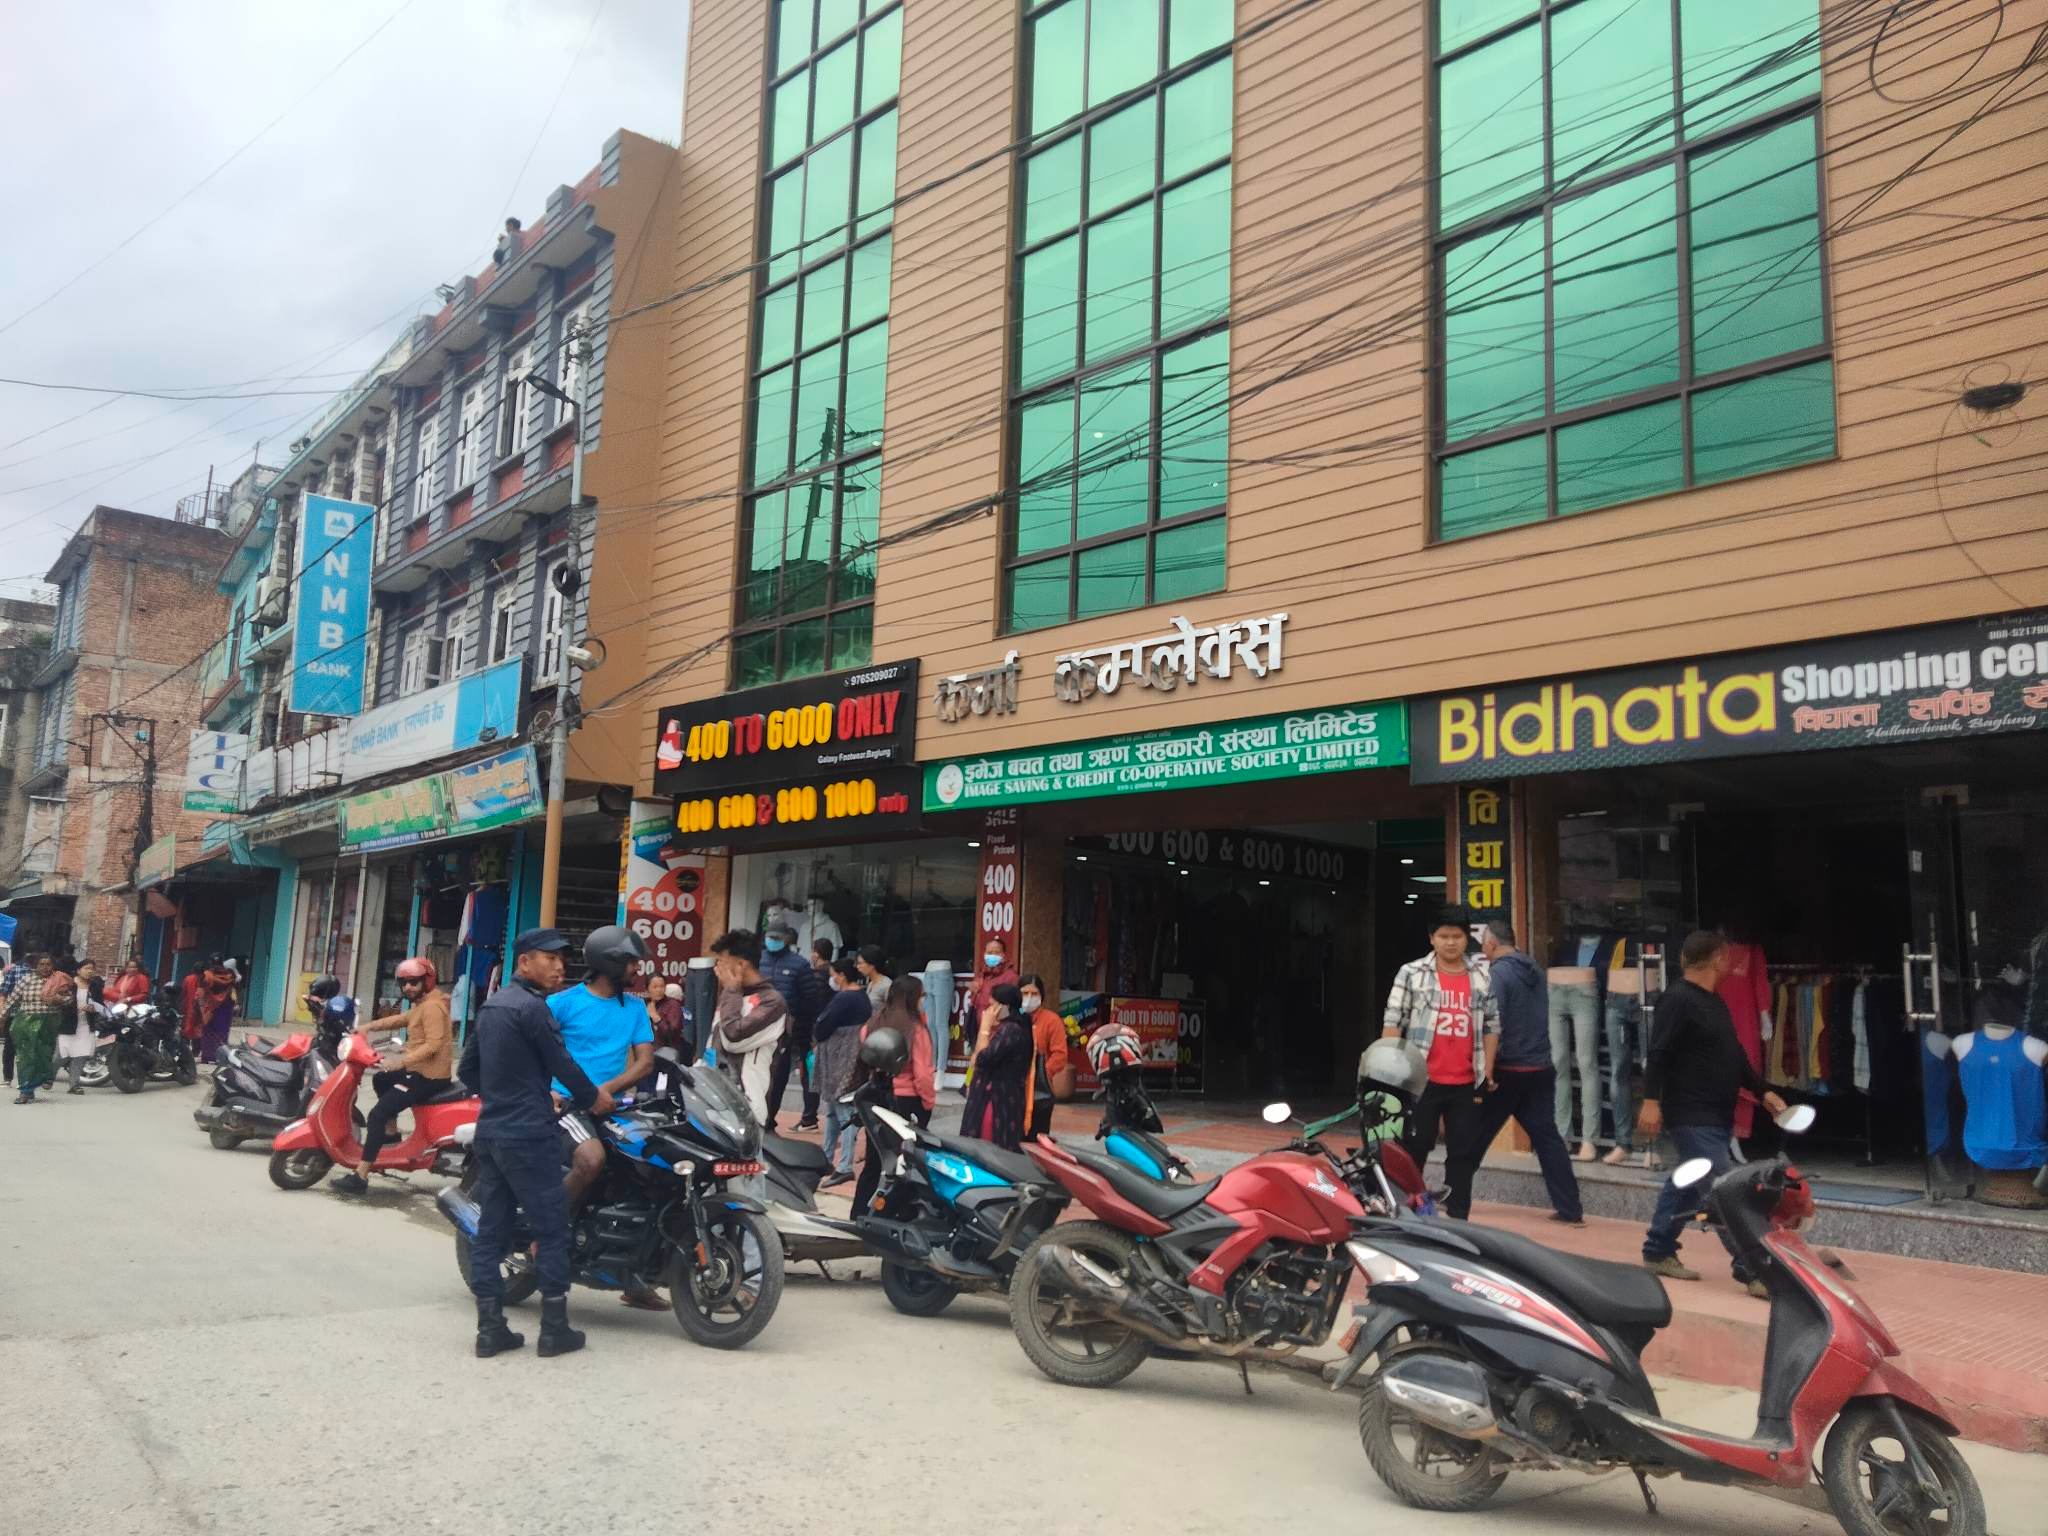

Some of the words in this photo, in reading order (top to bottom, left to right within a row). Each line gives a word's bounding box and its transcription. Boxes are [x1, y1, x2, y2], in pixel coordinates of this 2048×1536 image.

[307, 661, 351, 678] BANK
[1439, 666, 1777, 765] Bidhata
[1782, 650, 1971, 703] Shopping
[686, 719, 730, 762] 400
[735, 713, 762, 756] TO
[766, 701, 833, 751] 6000
[837, 690, 900, 741] ONLY
[965, 757, 1003, 783] इमेज
[1007, 756, 1044, 776] बचत
[1049, 751, 1084, 773] तथा
[1088, 744, 1130, 768] ऋण
[1135, 731, 1214, 762] सहकारी
[1219, 728, 1278, 754] संस्था
[1284, 710, 1379, 744] लिमिटेड
[964, 782, 1001, 799] IMAGE
[1004, 776, 1049, 796] SAVING
[1052, 776, 1063, 791] &
[1067, 768, 1115, 790] CREDIT
[1119, 757, 1227, 782] CO-OPERATIVE
[1231, 748, 1301, 772] SOCIETY
[1305, 739, 1380, 763] LIMITED
[677, 799, 714, 833] 400
[718, 793, 756, 829] 600
[776, 785, 817, 824] 800
[823, 777, 876, 819] 1000
[1161, 830, 1208, 864] 600
[1219, 836, 1234, 862] &
[1242, 837, 1284, 872] 800
[1293, 843, 1344, 882] 1000
[984, 864, 1015, 894] 400
[634, 891, 696, 912] 400
[982, 901, 1014, 933] 600
[632, 918, 694, 940] 600
[657, 943, 668, 958] &
[1118, 1010, 1137, 1025] 400
[1137, 1010, 1149, 1025] TO
[1151, 1010, 1176, 1026] 6000
[1436, 1011, 1469, 1038] 23
